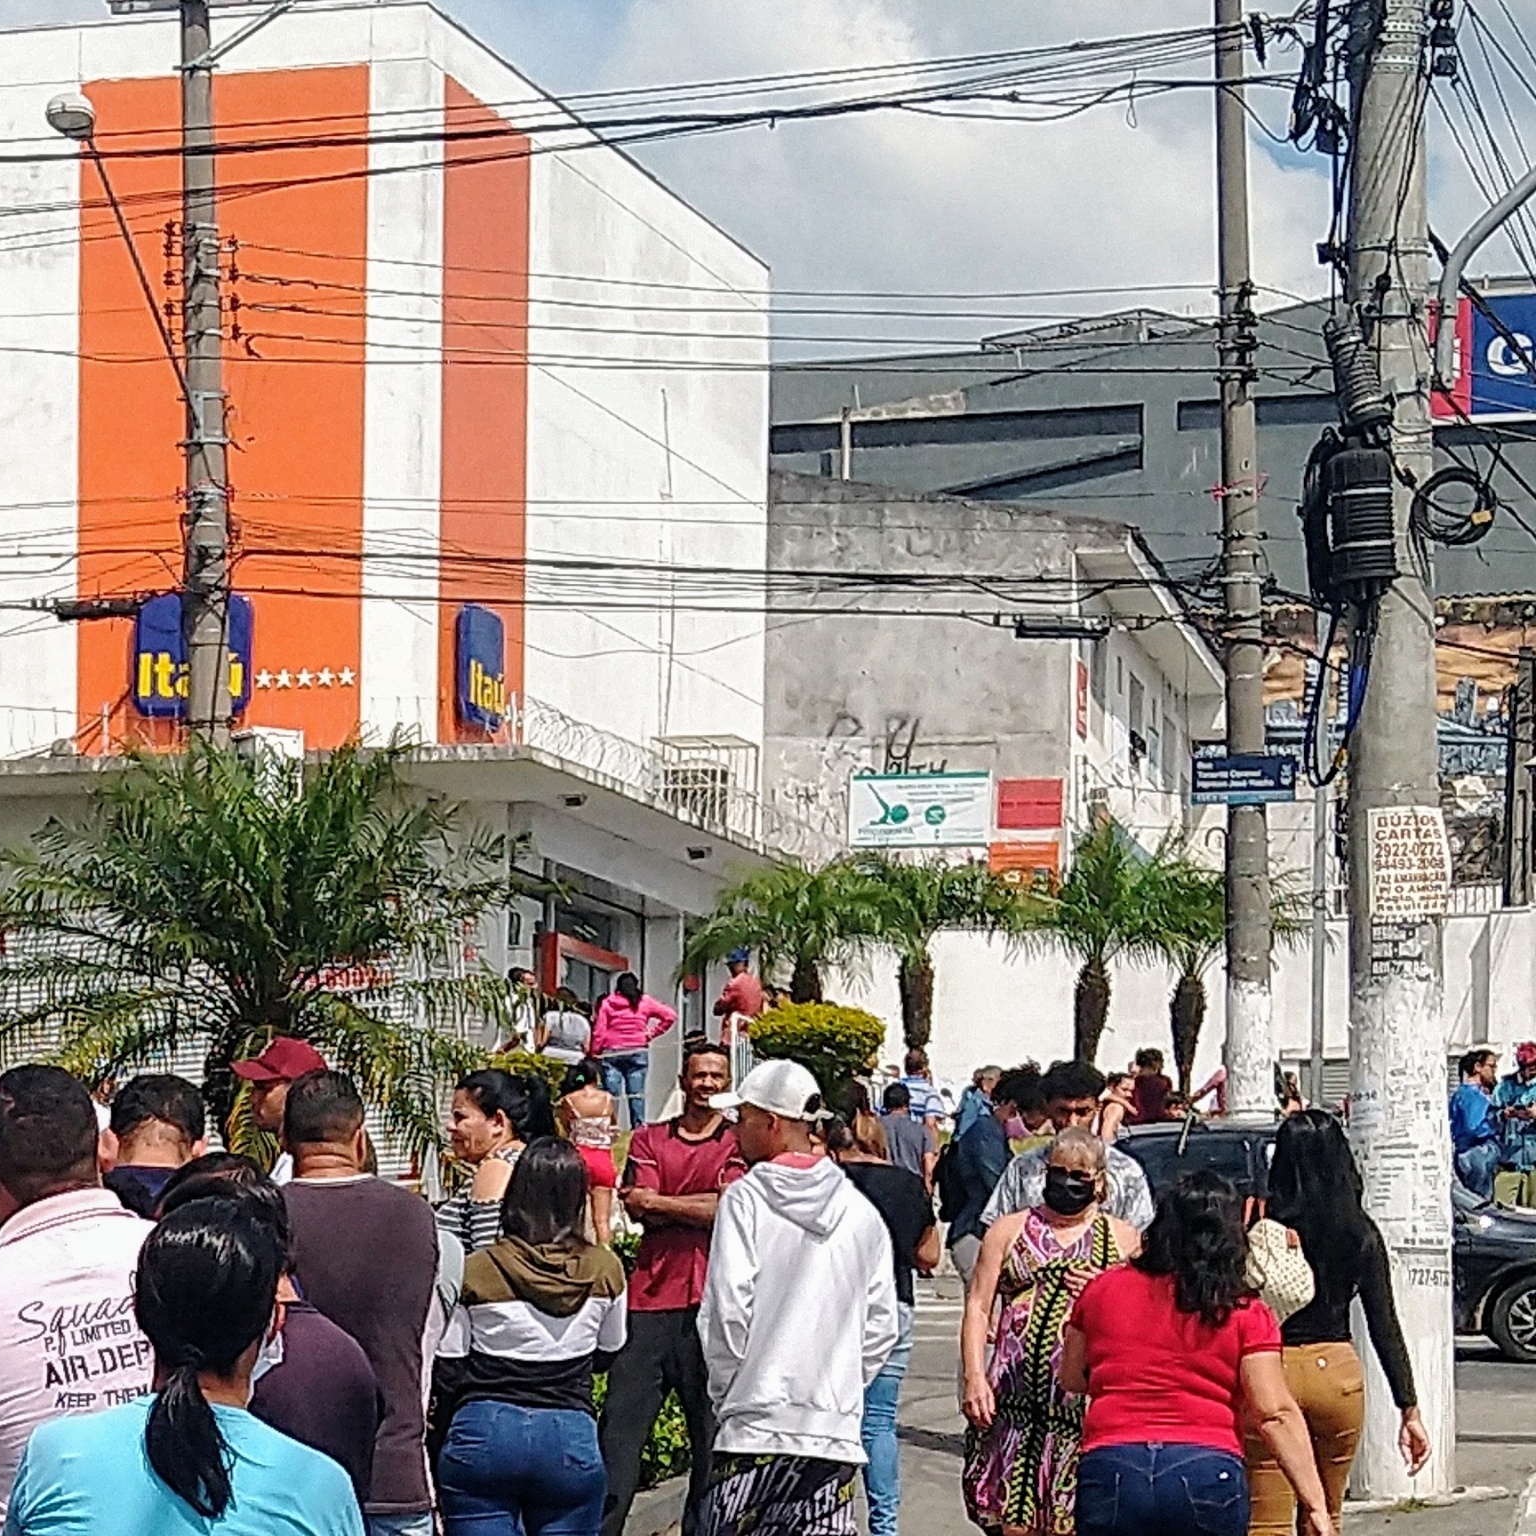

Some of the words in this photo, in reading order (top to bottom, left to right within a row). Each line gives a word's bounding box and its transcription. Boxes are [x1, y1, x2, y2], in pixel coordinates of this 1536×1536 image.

[469, 658, 505, 716] Itaú
[1375, 828, 1442, 841] CARTAS
[1375, 841, 1444, 858] 2922-0272
[1394, 885, 1404, 894] O
[1408, 884, 1442, 893] AMOR
[71, 1319, 131, 1346] LIMITED
[54, 1391, 97, 1409] KEEP
